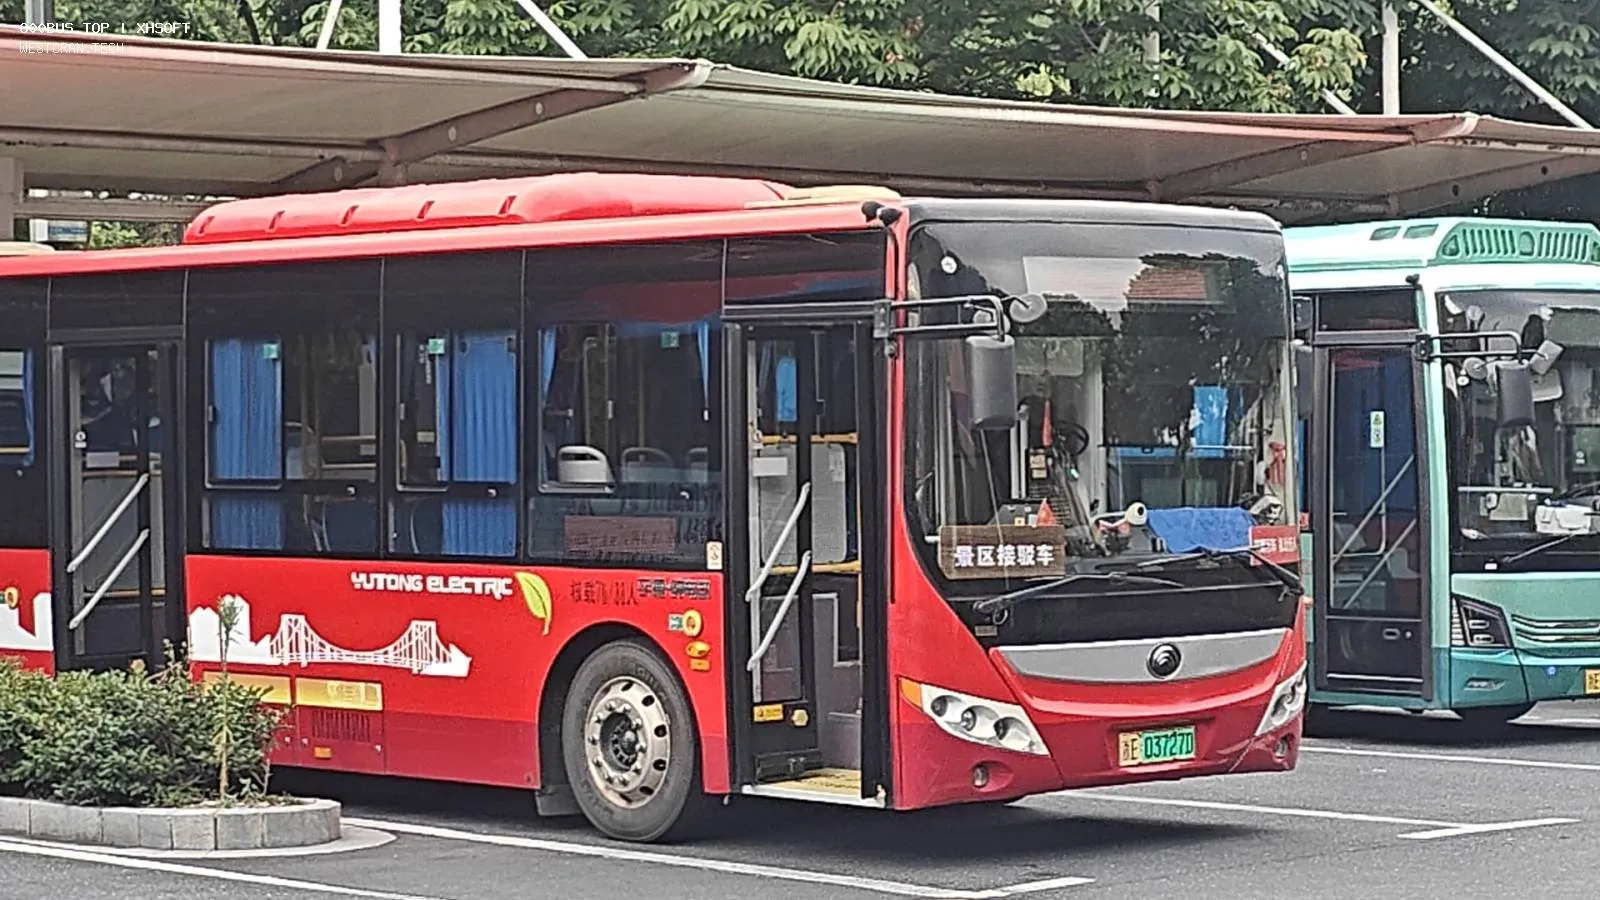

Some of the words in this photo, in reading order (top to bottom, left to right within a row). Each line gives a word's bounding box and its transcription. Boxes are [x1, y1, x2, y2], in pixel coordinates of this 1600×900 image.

[955, 544, 1055, 567] 景区接驳车
[351, 572, 423, 592] YUTONG
